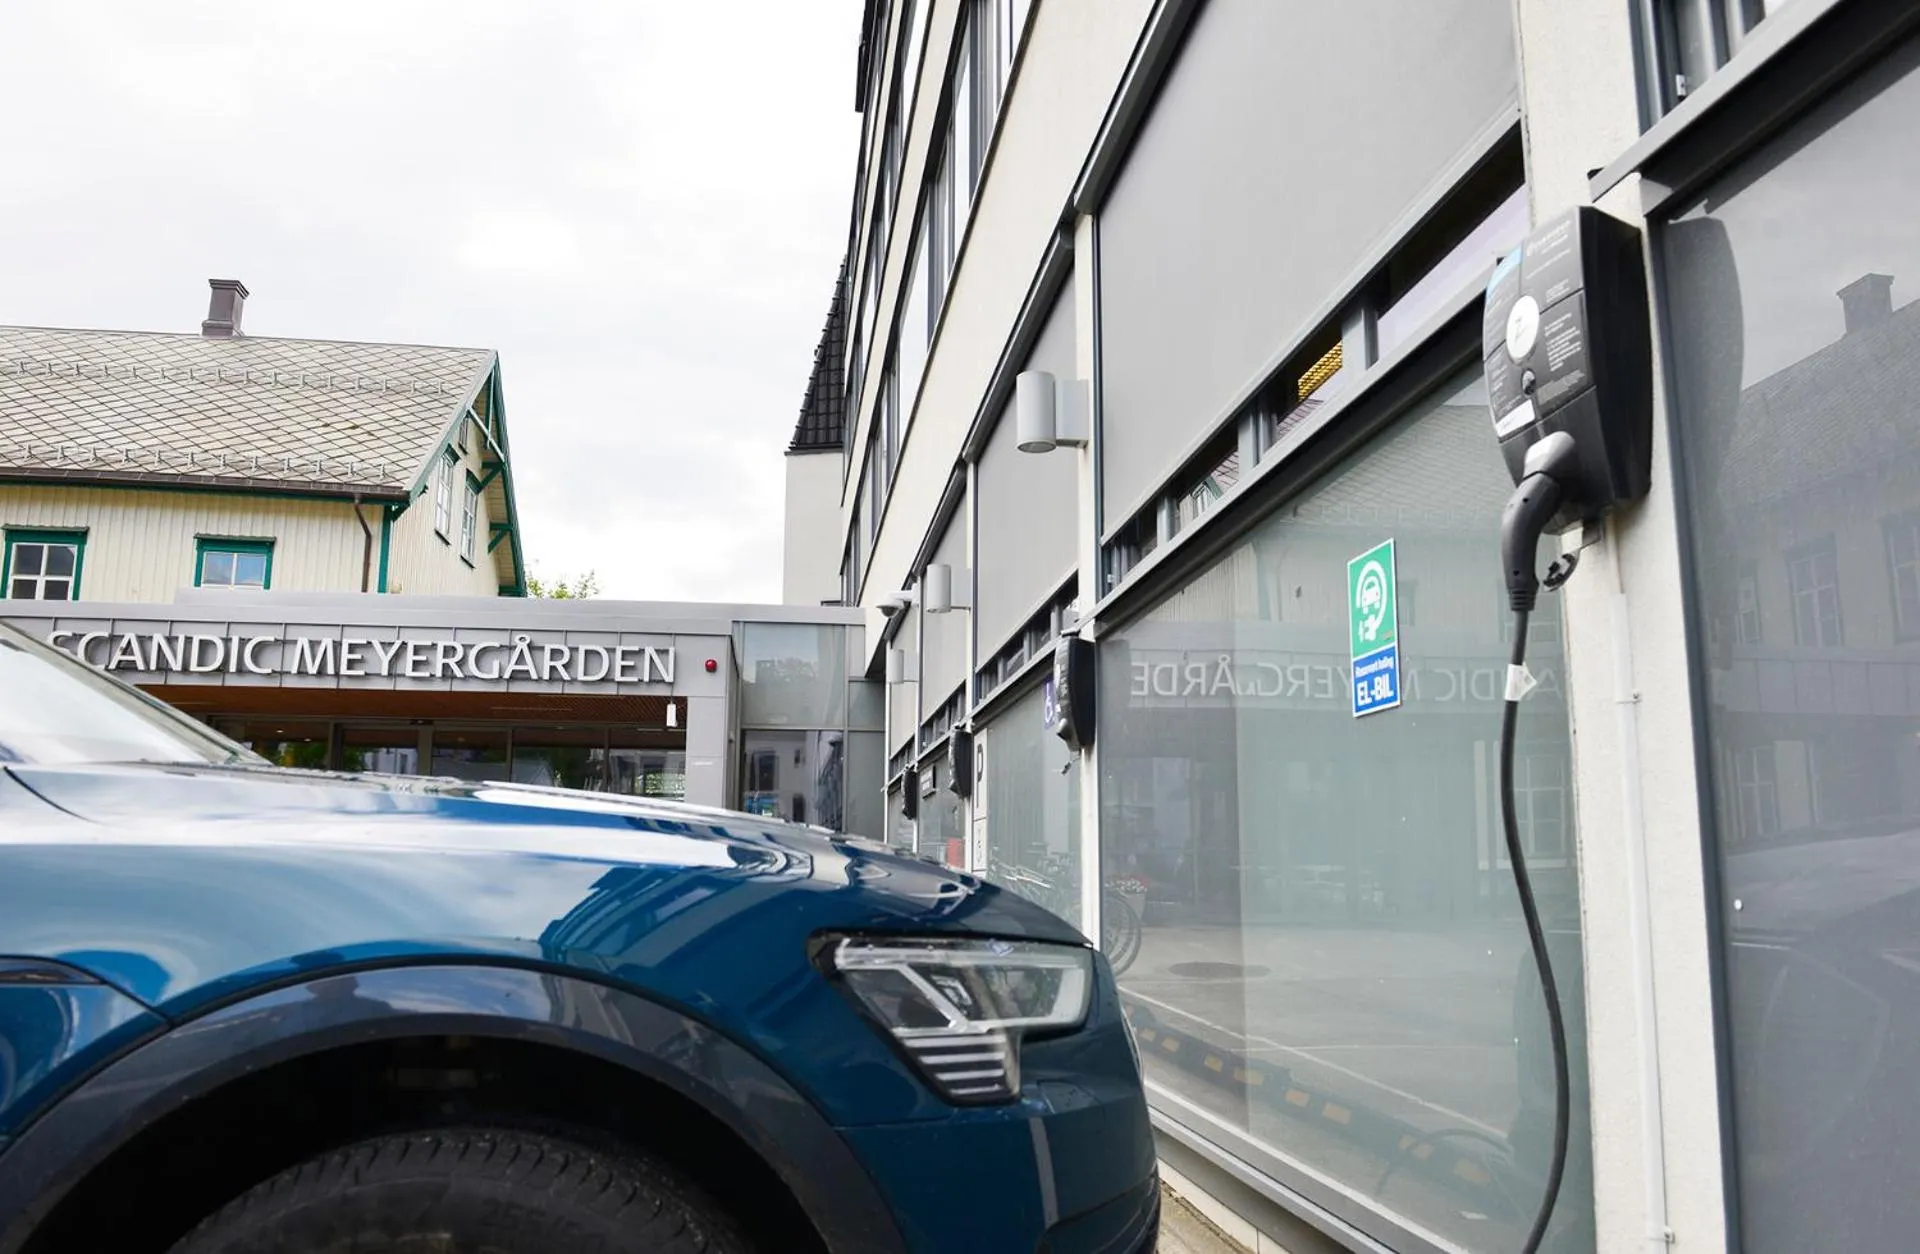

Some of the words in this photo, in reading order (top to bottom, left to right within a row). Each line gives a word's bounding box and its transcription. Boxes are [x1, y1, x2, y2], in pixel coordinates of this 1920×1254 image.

[47, 630, 276, 674] SCANDIC
[291, 633, 675, 683] MEYERGÅRDEN
[1357, 674, 1394, 706] EL-BIL
[976, 743, 984, 808] P
